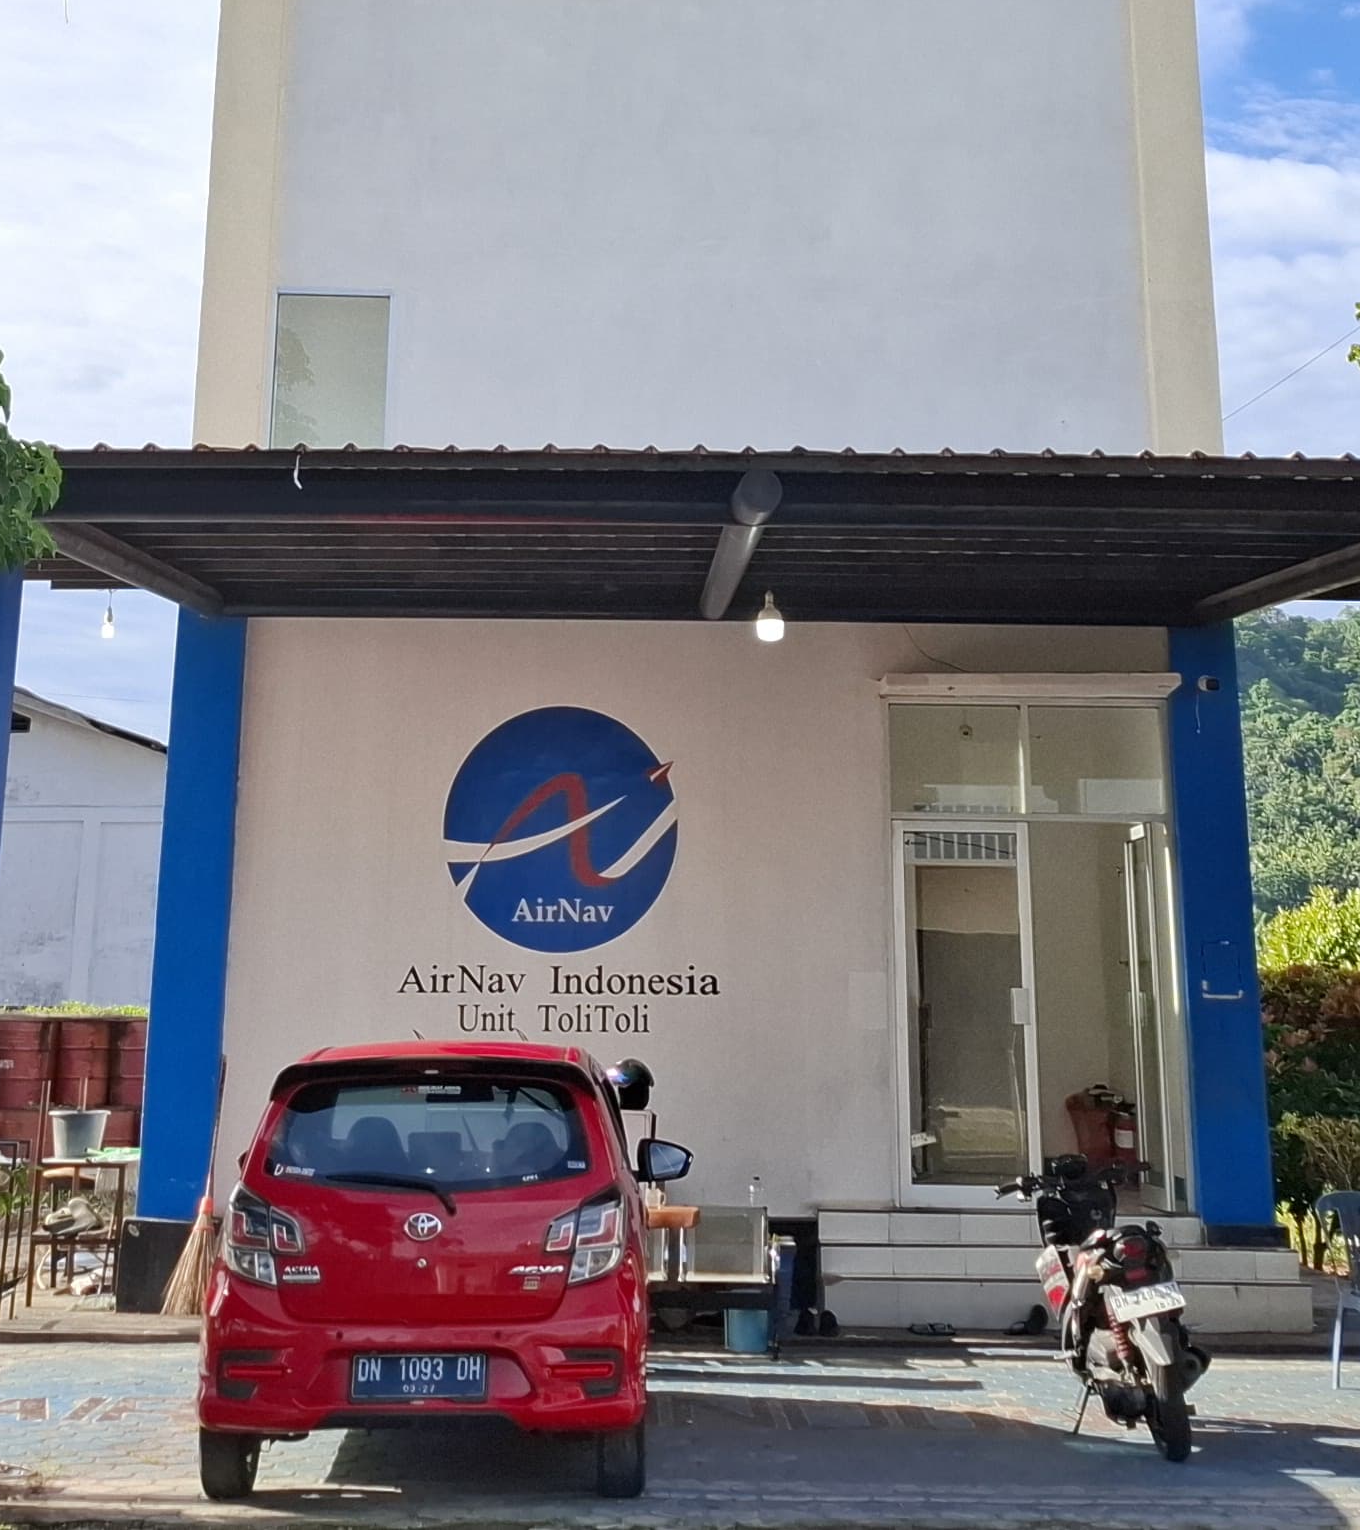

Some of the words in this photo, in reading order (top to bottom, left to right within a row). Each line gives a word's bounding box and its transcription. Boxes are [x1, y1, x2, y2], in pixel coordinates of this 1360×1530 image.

[511, 897, 615, 924] AirNav
[397, 964, 526, 996] AirNav
[549, 964, 721, 996] Indonesia
[457, 1003, 515, 1033] Unit
[537, 1003, 650, 1034] ToliToli
[357, 1357, 382, 1382] DN
[399, 1357, 444, 1382] 1093
[456, 1355, 481, 1382] DH
